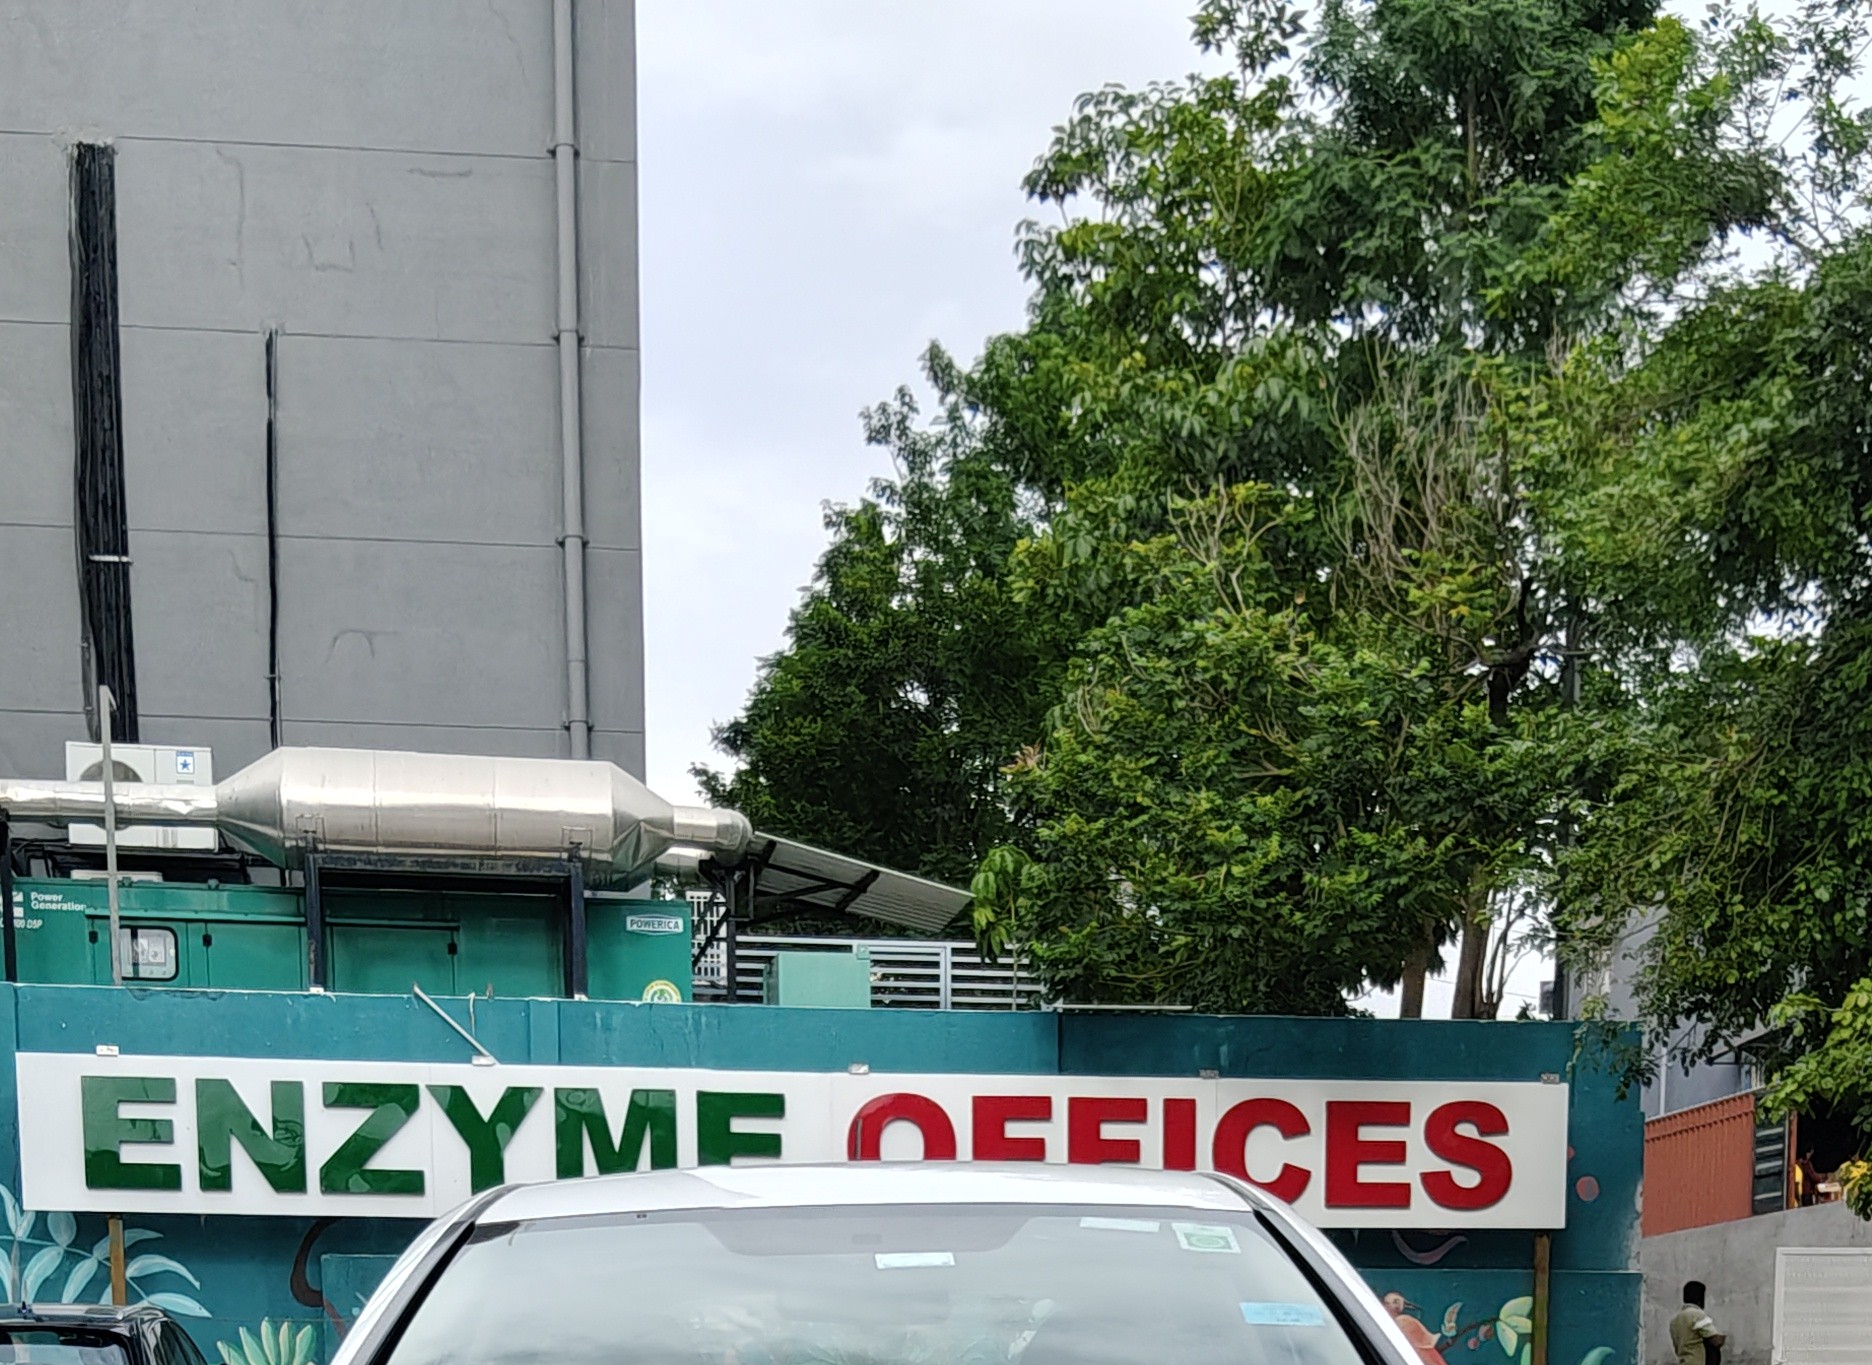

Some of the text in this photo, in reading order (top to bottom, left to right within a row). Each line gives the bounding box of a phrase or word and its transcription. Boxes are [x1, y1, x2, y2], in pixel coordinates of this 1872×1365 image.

[30, 892, 63, 901] Power
[31, 901, 87, 911] Generation
[630, 919, 680, 930] POWERICA
[81, 1076, 1512, 1210] ENZYME OFFICES
